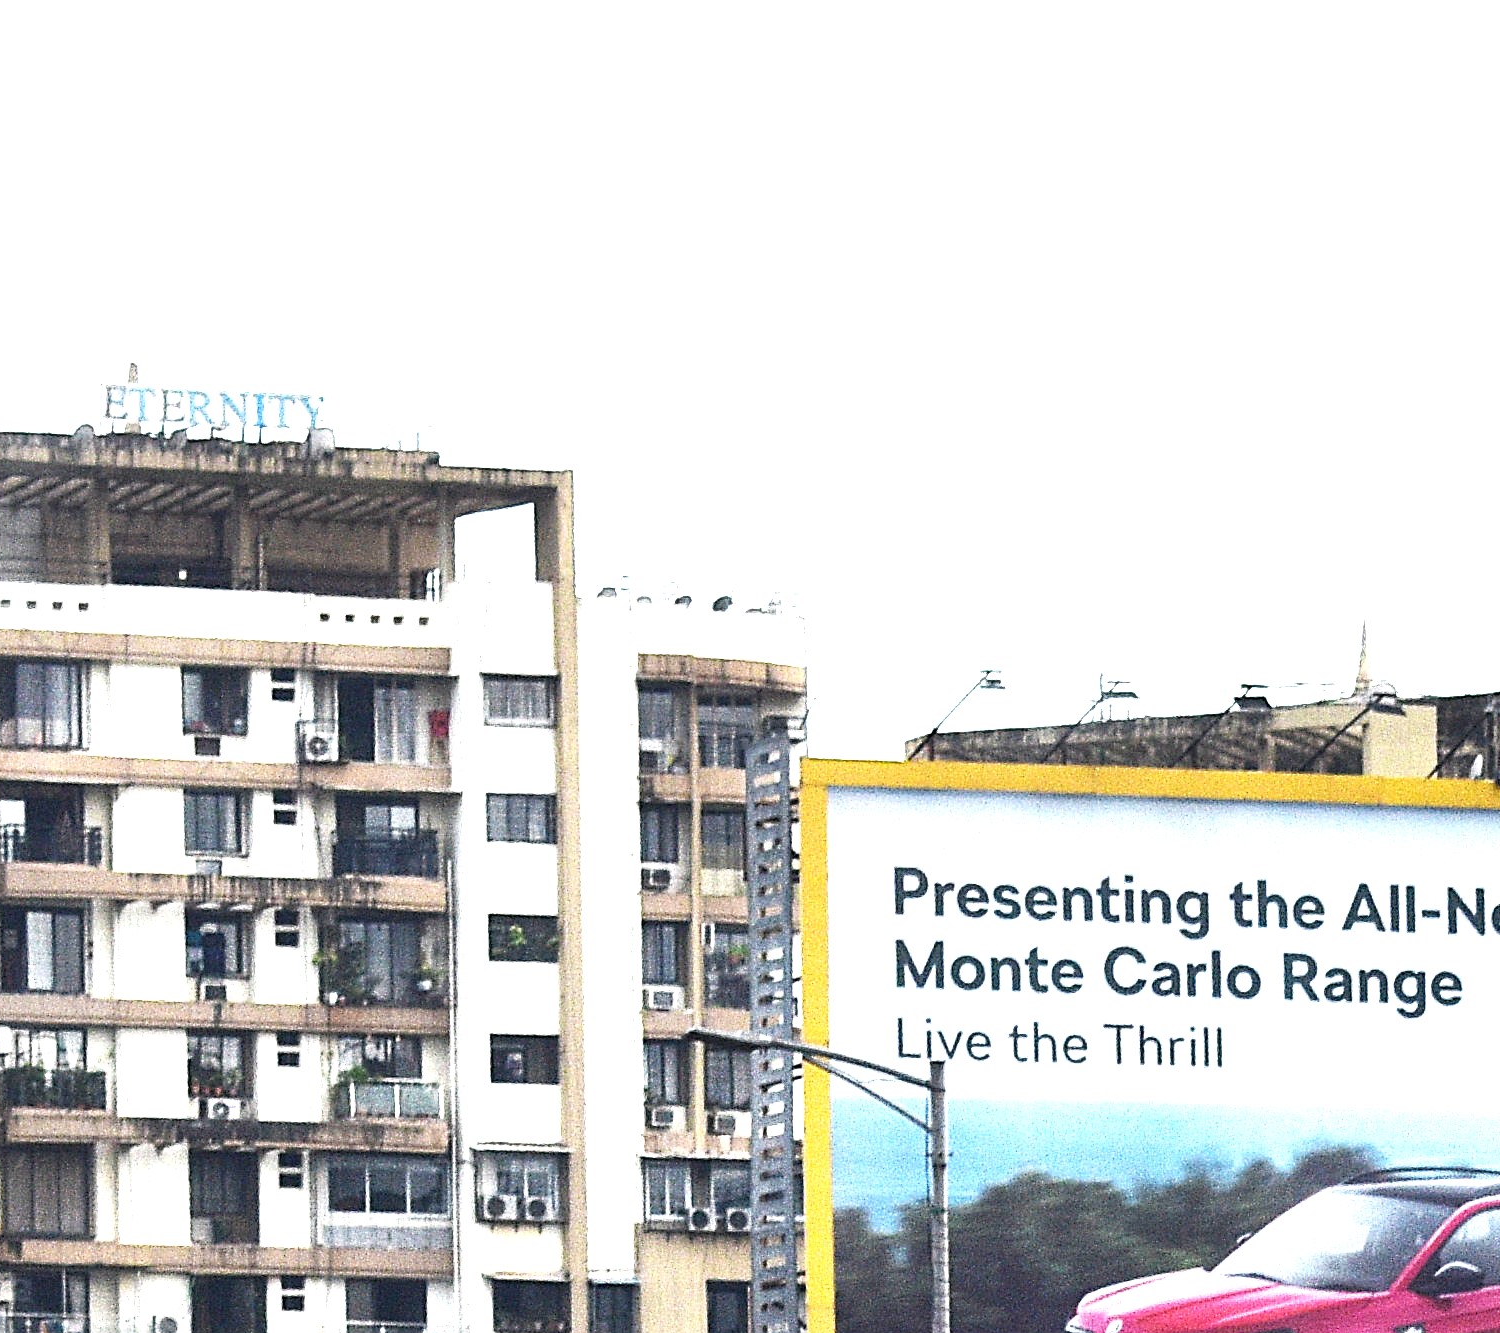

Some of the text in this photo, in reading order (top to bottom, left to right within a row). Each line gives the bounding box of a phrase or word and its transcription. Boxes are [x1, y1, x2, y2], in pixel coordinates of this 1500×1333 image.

[105, 384, 324, 429] ETERNITY
[893, 866, 1210, 938] Presenting
[1230, 879, 1325, 930] the
[895, 940, 1463, 1018] Monte Carlo Range
[897, 1017, 1225, 1068] Live the Thrill
